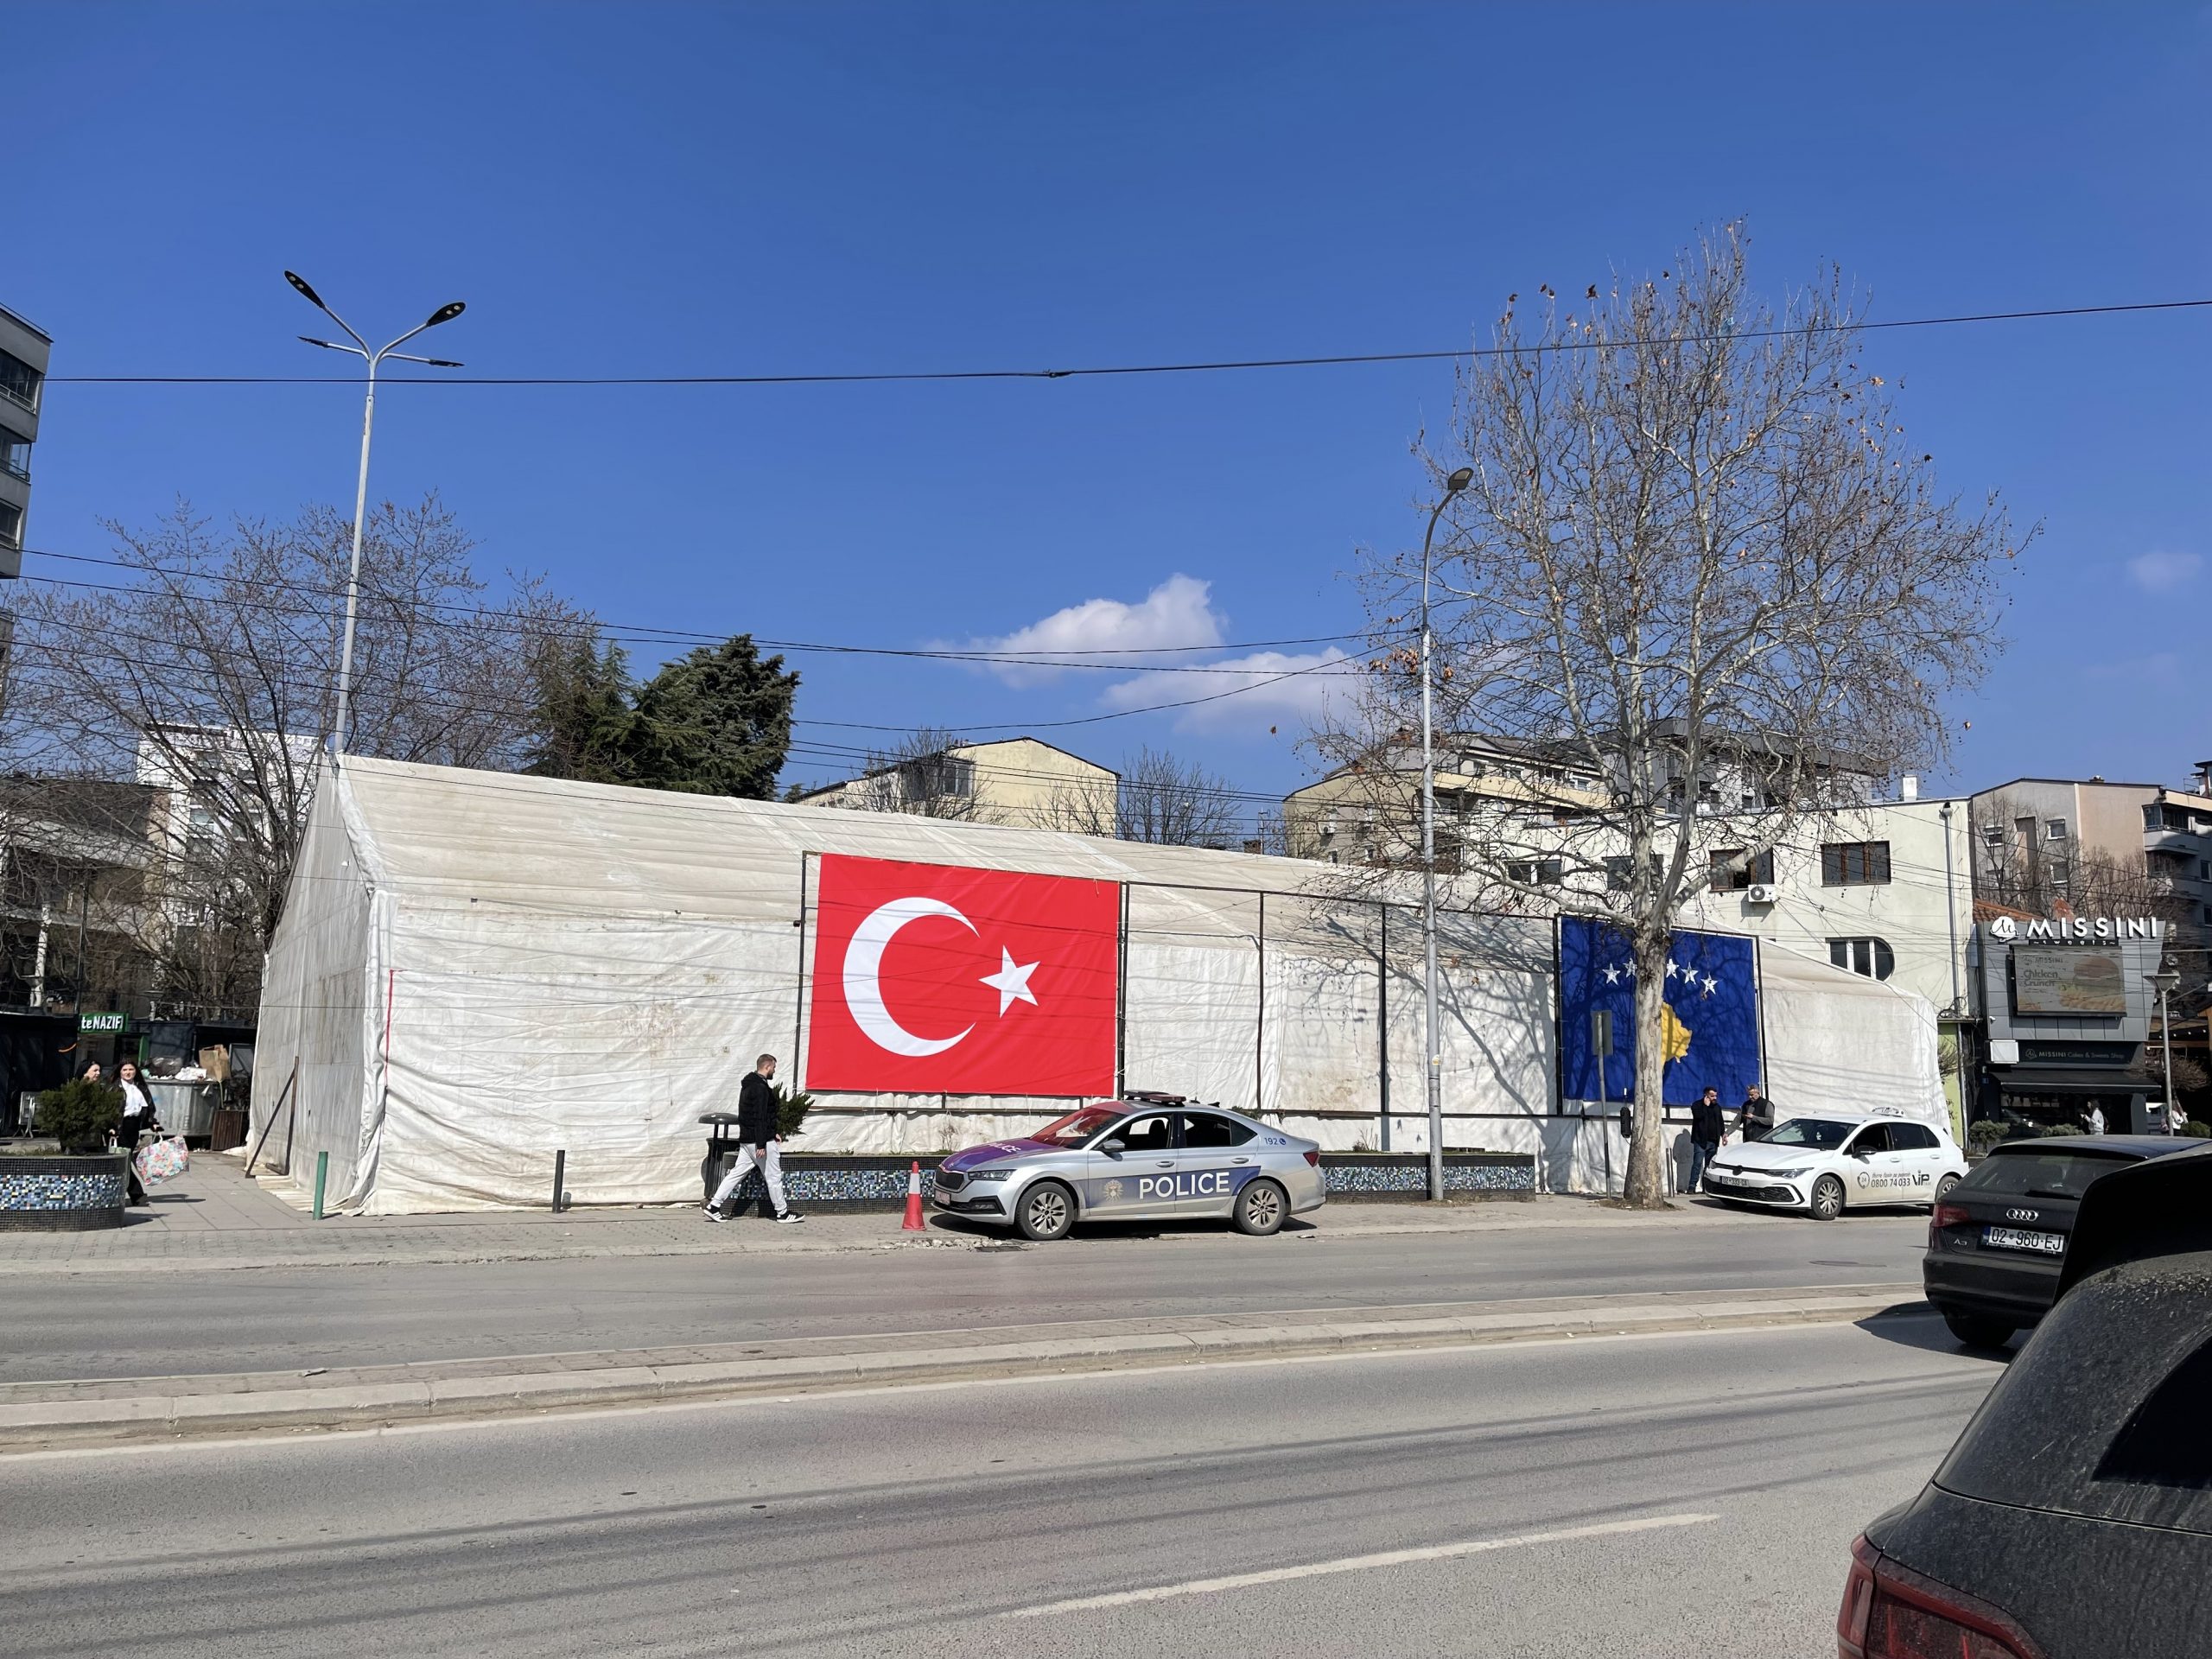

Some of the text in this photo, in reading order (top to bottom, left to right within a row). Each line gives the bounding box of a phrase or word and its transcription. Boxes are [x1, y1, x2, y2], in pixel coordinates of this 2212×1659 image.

[2026, 917, 2158, 938] MISSINI
[2024, 969, 2058, 979] Chicken
[1264, 1137, 1279, 1146] 192
[1139, 1172, 1230, 1200] POLICE
[1872, 1178, 1910, 1187] 0800 74 033
[1954, 1237, 1967, 1246] A3
